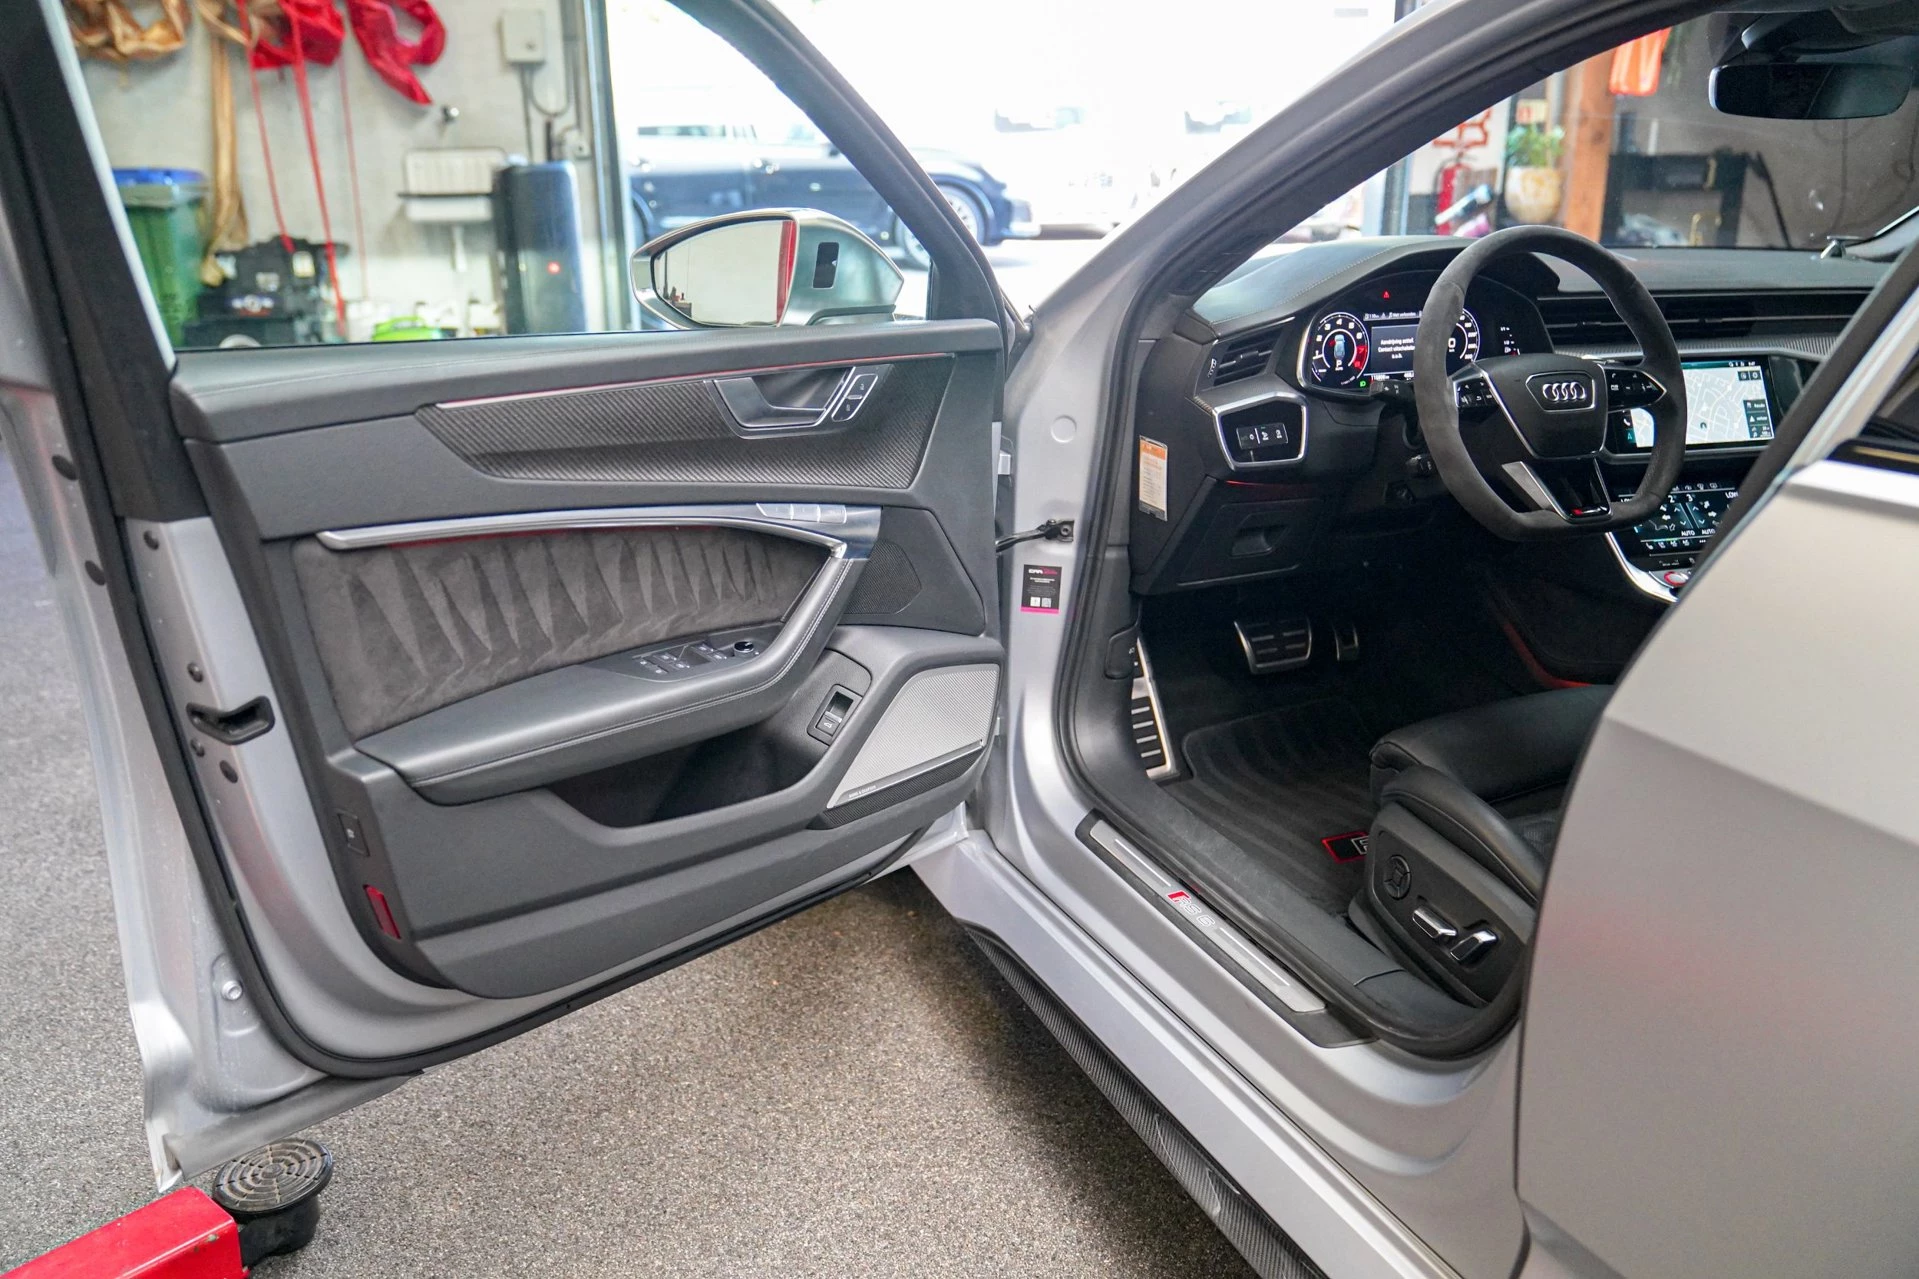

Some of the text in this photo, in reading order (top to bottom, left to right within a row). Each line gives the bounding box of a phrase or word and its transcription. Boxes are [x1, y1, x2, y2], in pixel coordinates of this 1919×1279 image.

[1336, 360, 1342, 368] P
[1173, 893, 1216, 927] RS 6
